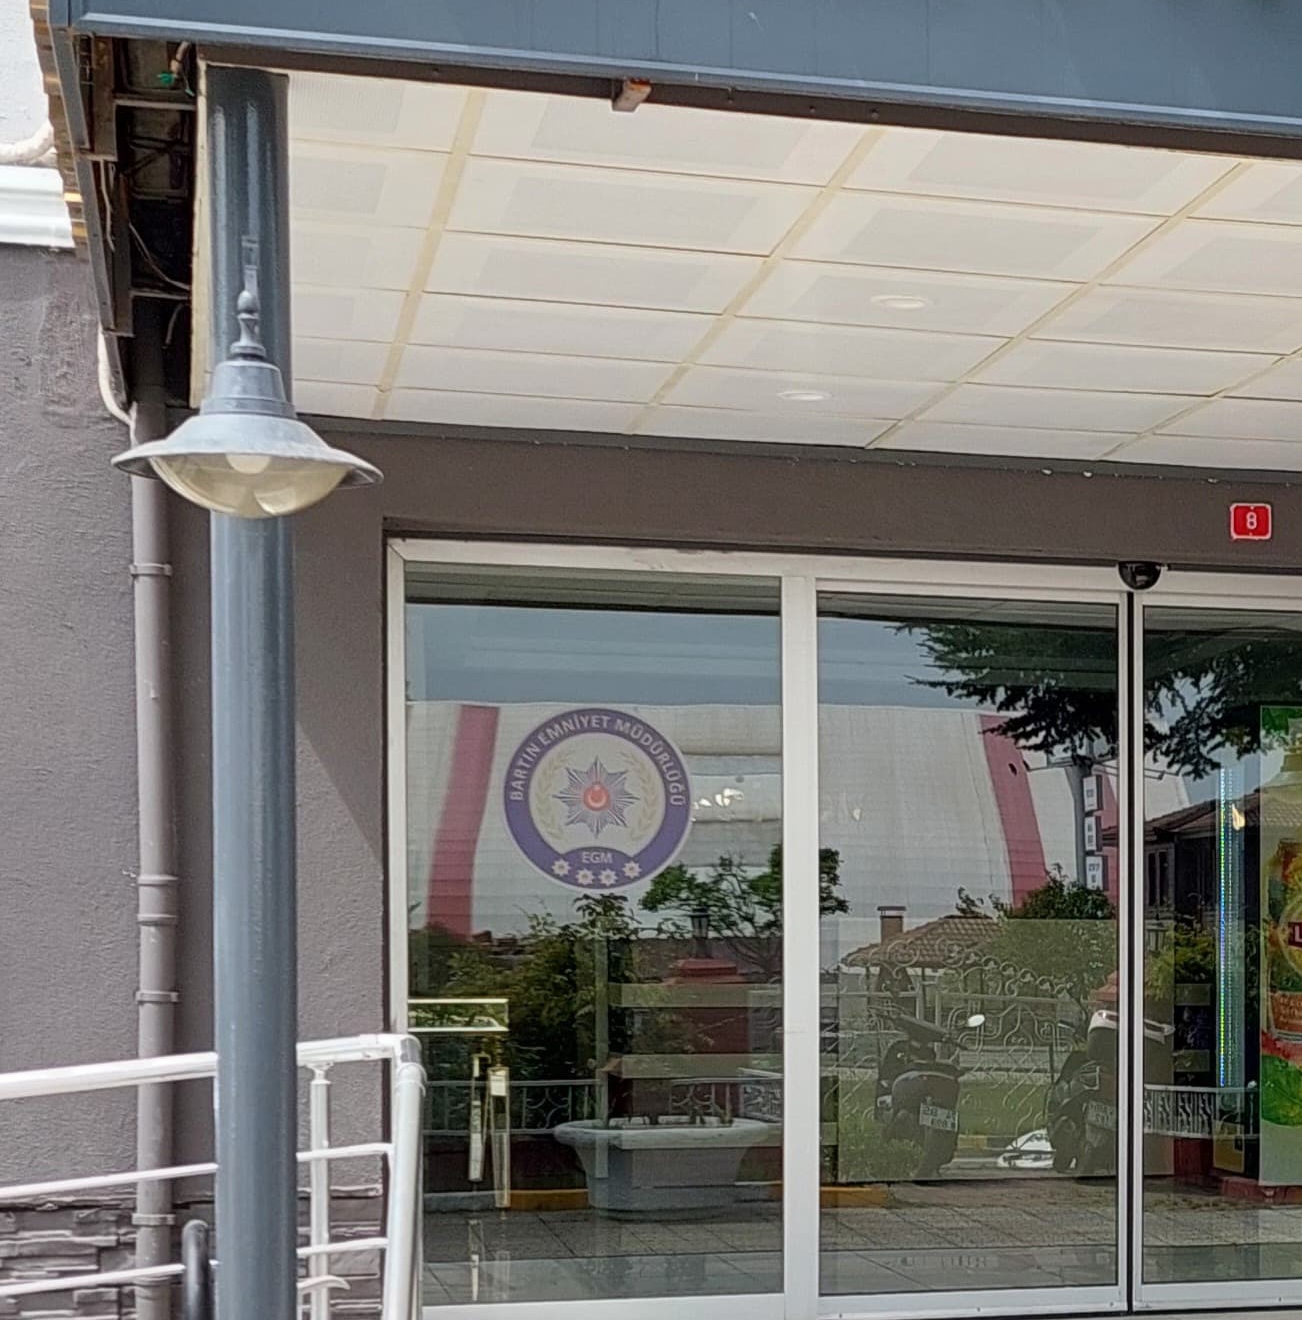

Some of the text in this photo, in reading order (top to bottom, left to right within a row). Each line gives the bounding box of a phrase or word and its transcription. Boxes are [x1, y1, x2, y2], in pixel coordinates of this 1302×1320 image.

[510, 713, 685, 807] BARTIN EMNİYET MÜDÜRLÜĞÜ
[581, 850, 613, 864] EGM
